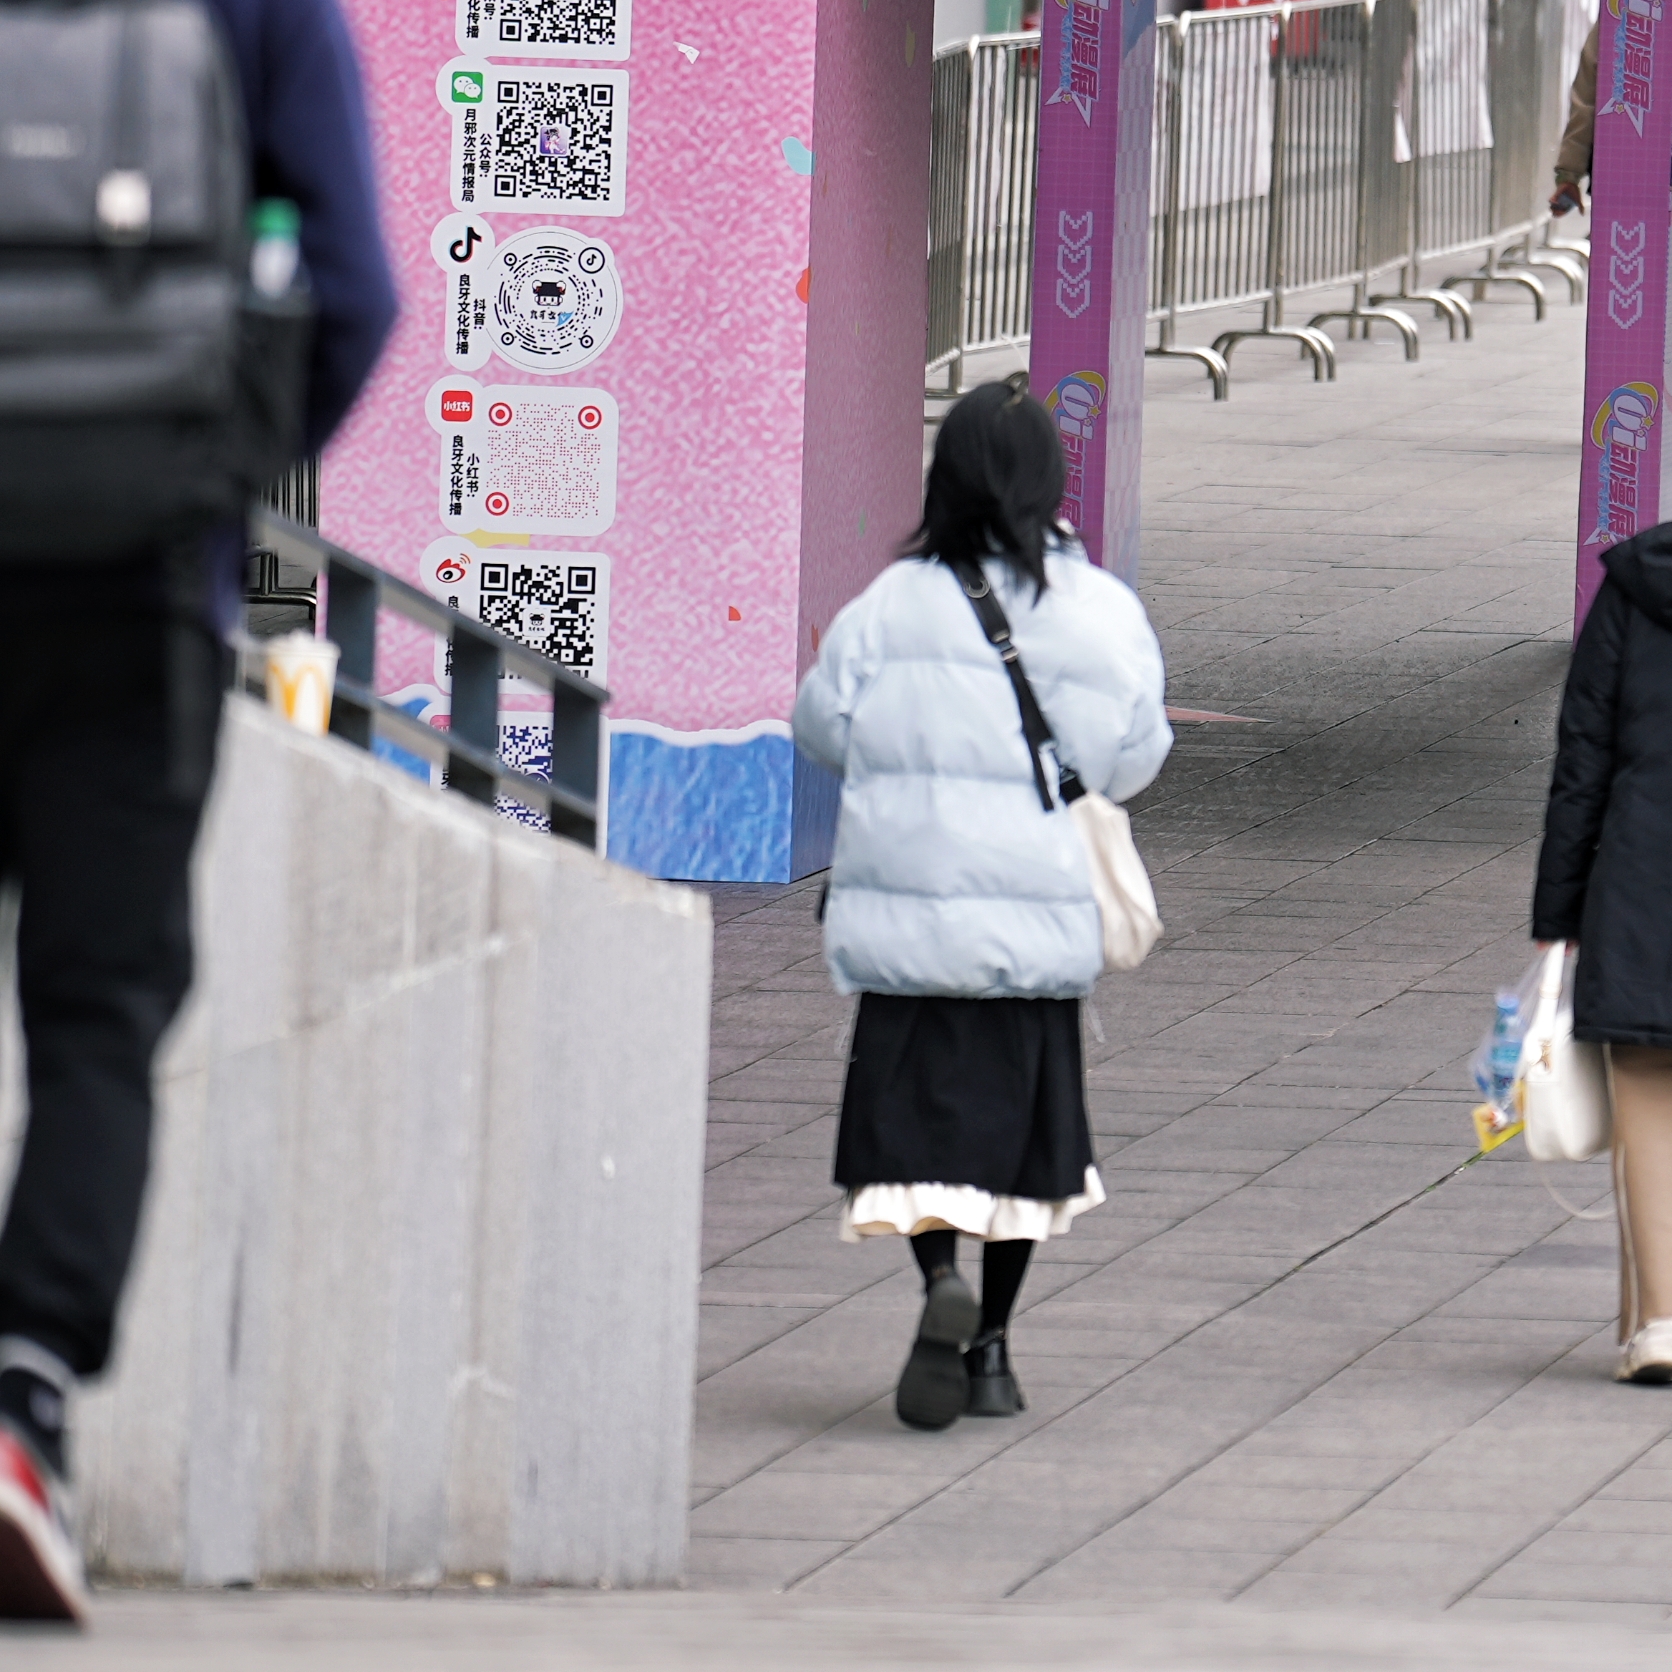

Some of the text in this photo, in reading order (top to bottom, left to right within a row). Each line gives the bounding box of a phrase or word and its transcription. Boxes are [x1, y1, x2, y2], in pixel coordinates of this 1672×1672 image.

[455, 273, 471, 355] 良牙文化传播
[443, 400, 471, 413] 小红书
[449, 435, 464, 516] 良牙文化传播
